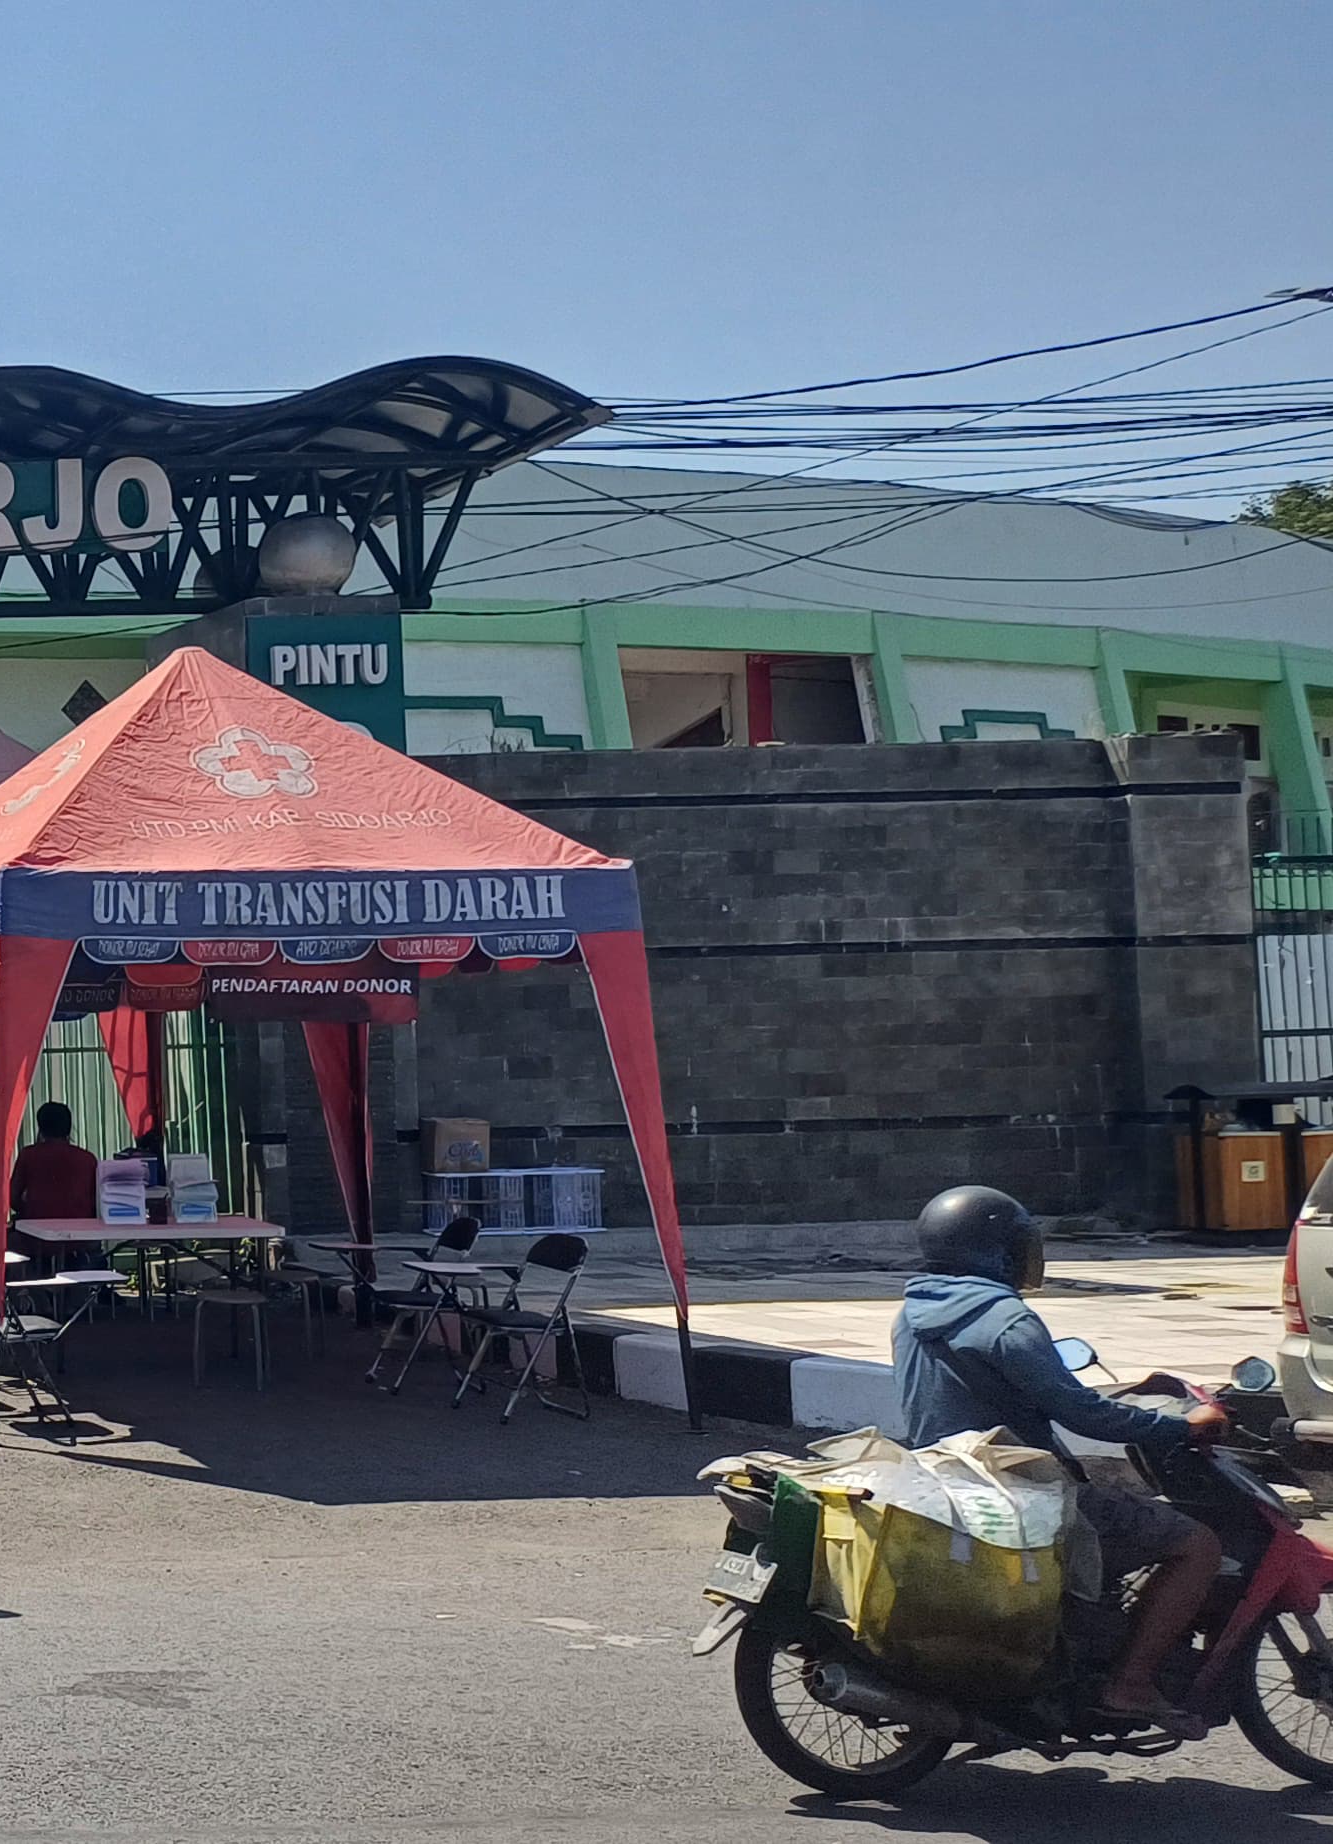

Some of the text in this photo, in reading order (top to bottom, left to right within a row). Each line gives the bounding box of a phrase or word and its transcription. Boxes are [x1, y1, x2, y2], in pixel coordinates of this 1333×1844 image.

[270, 644, 388, 685] PINTU
[315, 809, 451, 829] SIDOARJO
[92, 875, 566, 926] UNIT TRANSFUSI DARAH
[212, 978, 412, 994] PENDAFTARAN DONOR
